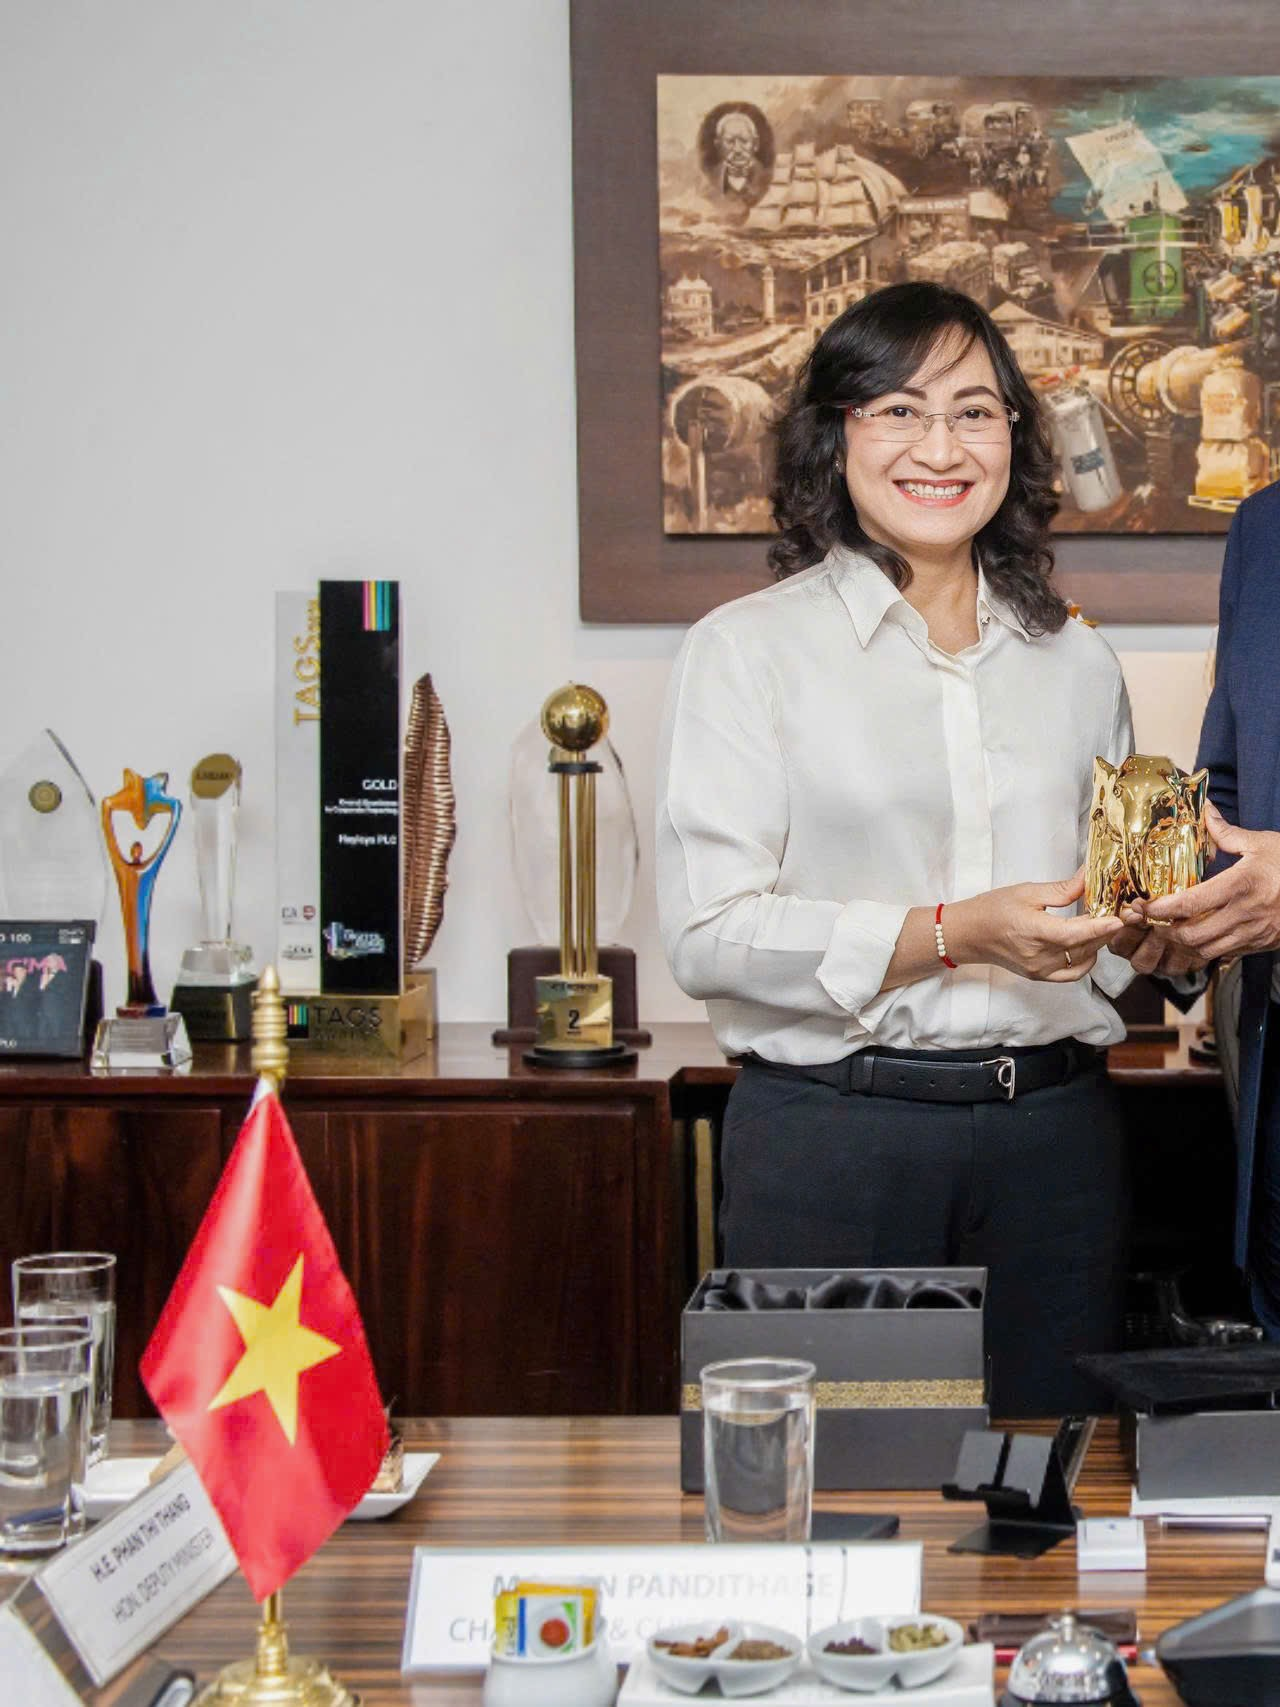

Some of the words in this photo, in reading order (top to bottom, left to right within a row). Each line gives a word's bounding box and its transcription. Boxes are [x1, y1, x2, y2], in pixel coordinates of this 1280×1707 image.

[293, 635, 320, 727] TAGS
[362, 779, 397, 790] GOLD
[313, 1006, 383, 1028] TAGS
[568, 1008, 581, 1030] 2
[136, 1561, 177, 1602] DEPUTY
[627, 1574, 833, 1599] PANDITHAE
[609, 1615, 627, 1640] &
